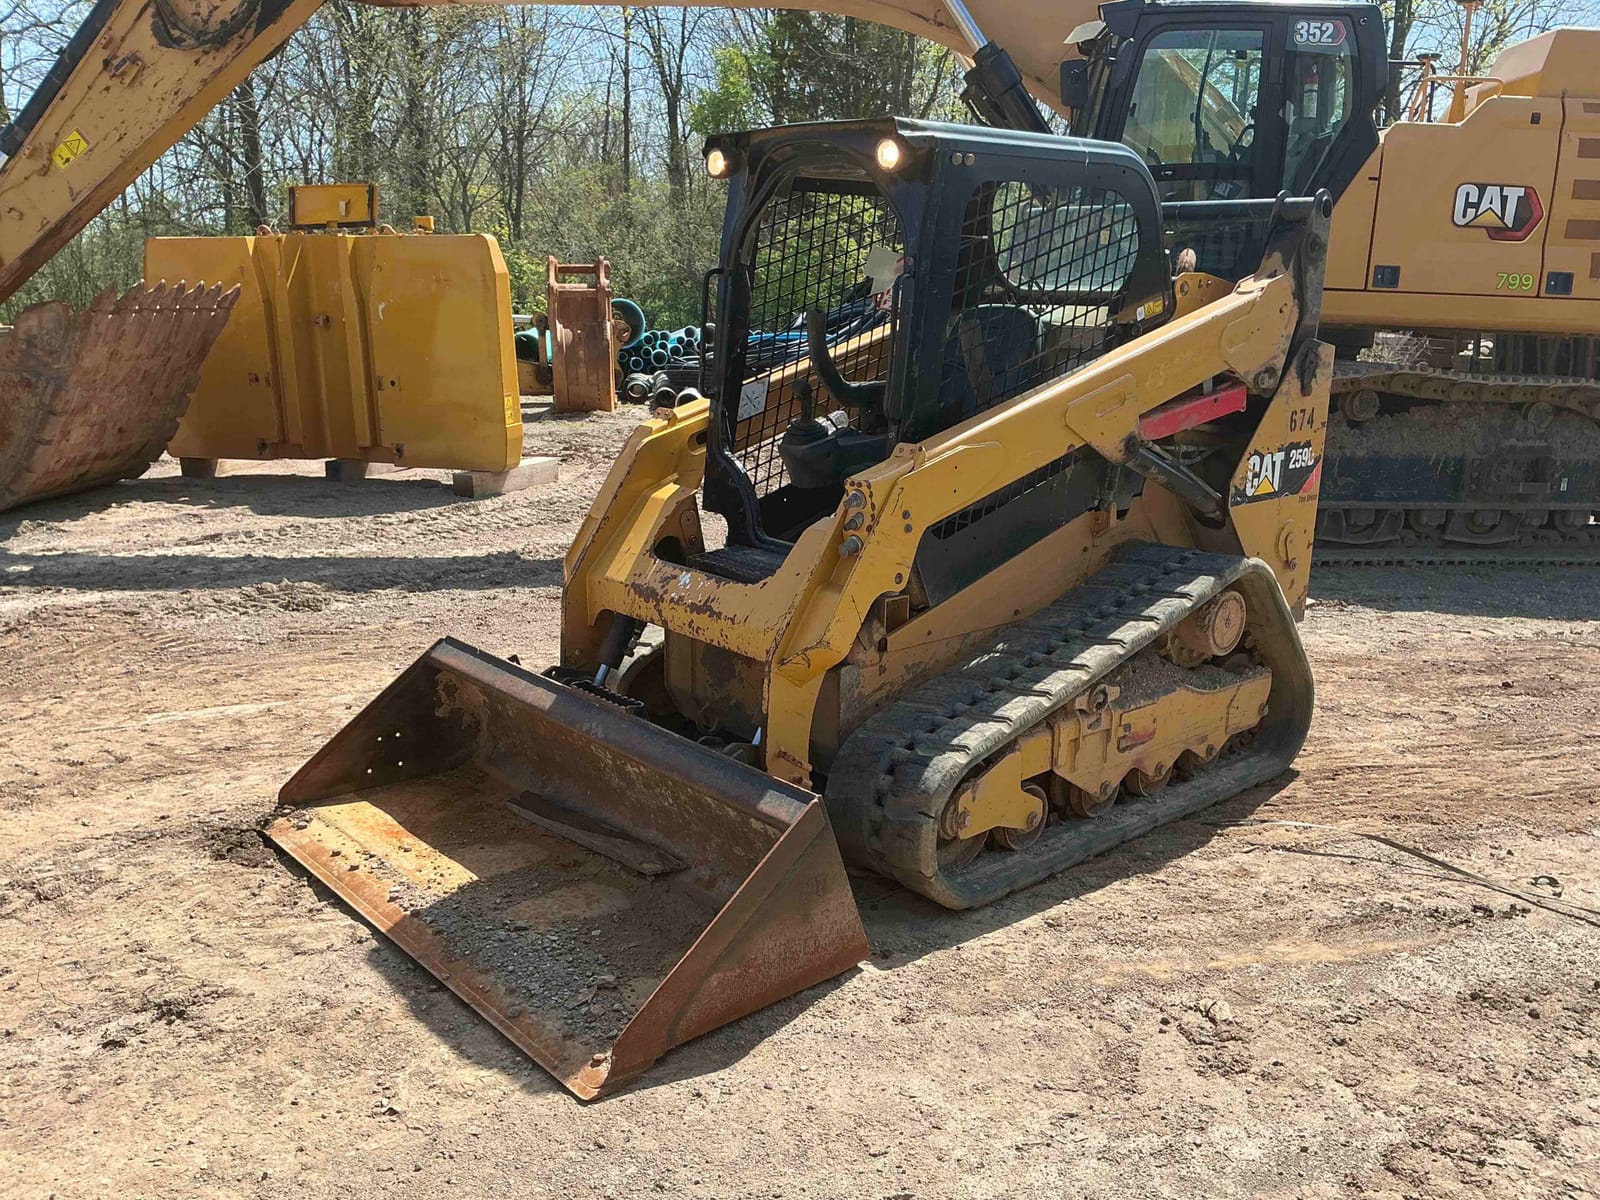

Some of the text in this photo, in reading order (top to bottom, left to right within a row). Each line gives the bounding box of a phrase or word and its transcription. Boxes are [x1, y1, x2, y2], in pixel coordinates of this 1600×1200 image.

[1295, 21, 1334, 43] 352
[1453, 184, 1525, 228] CAT
[1496, 273, 1533, 290] 799
[1289, 407, 1315, 432] 674
[1245, 451, 1285, 497] CAT
